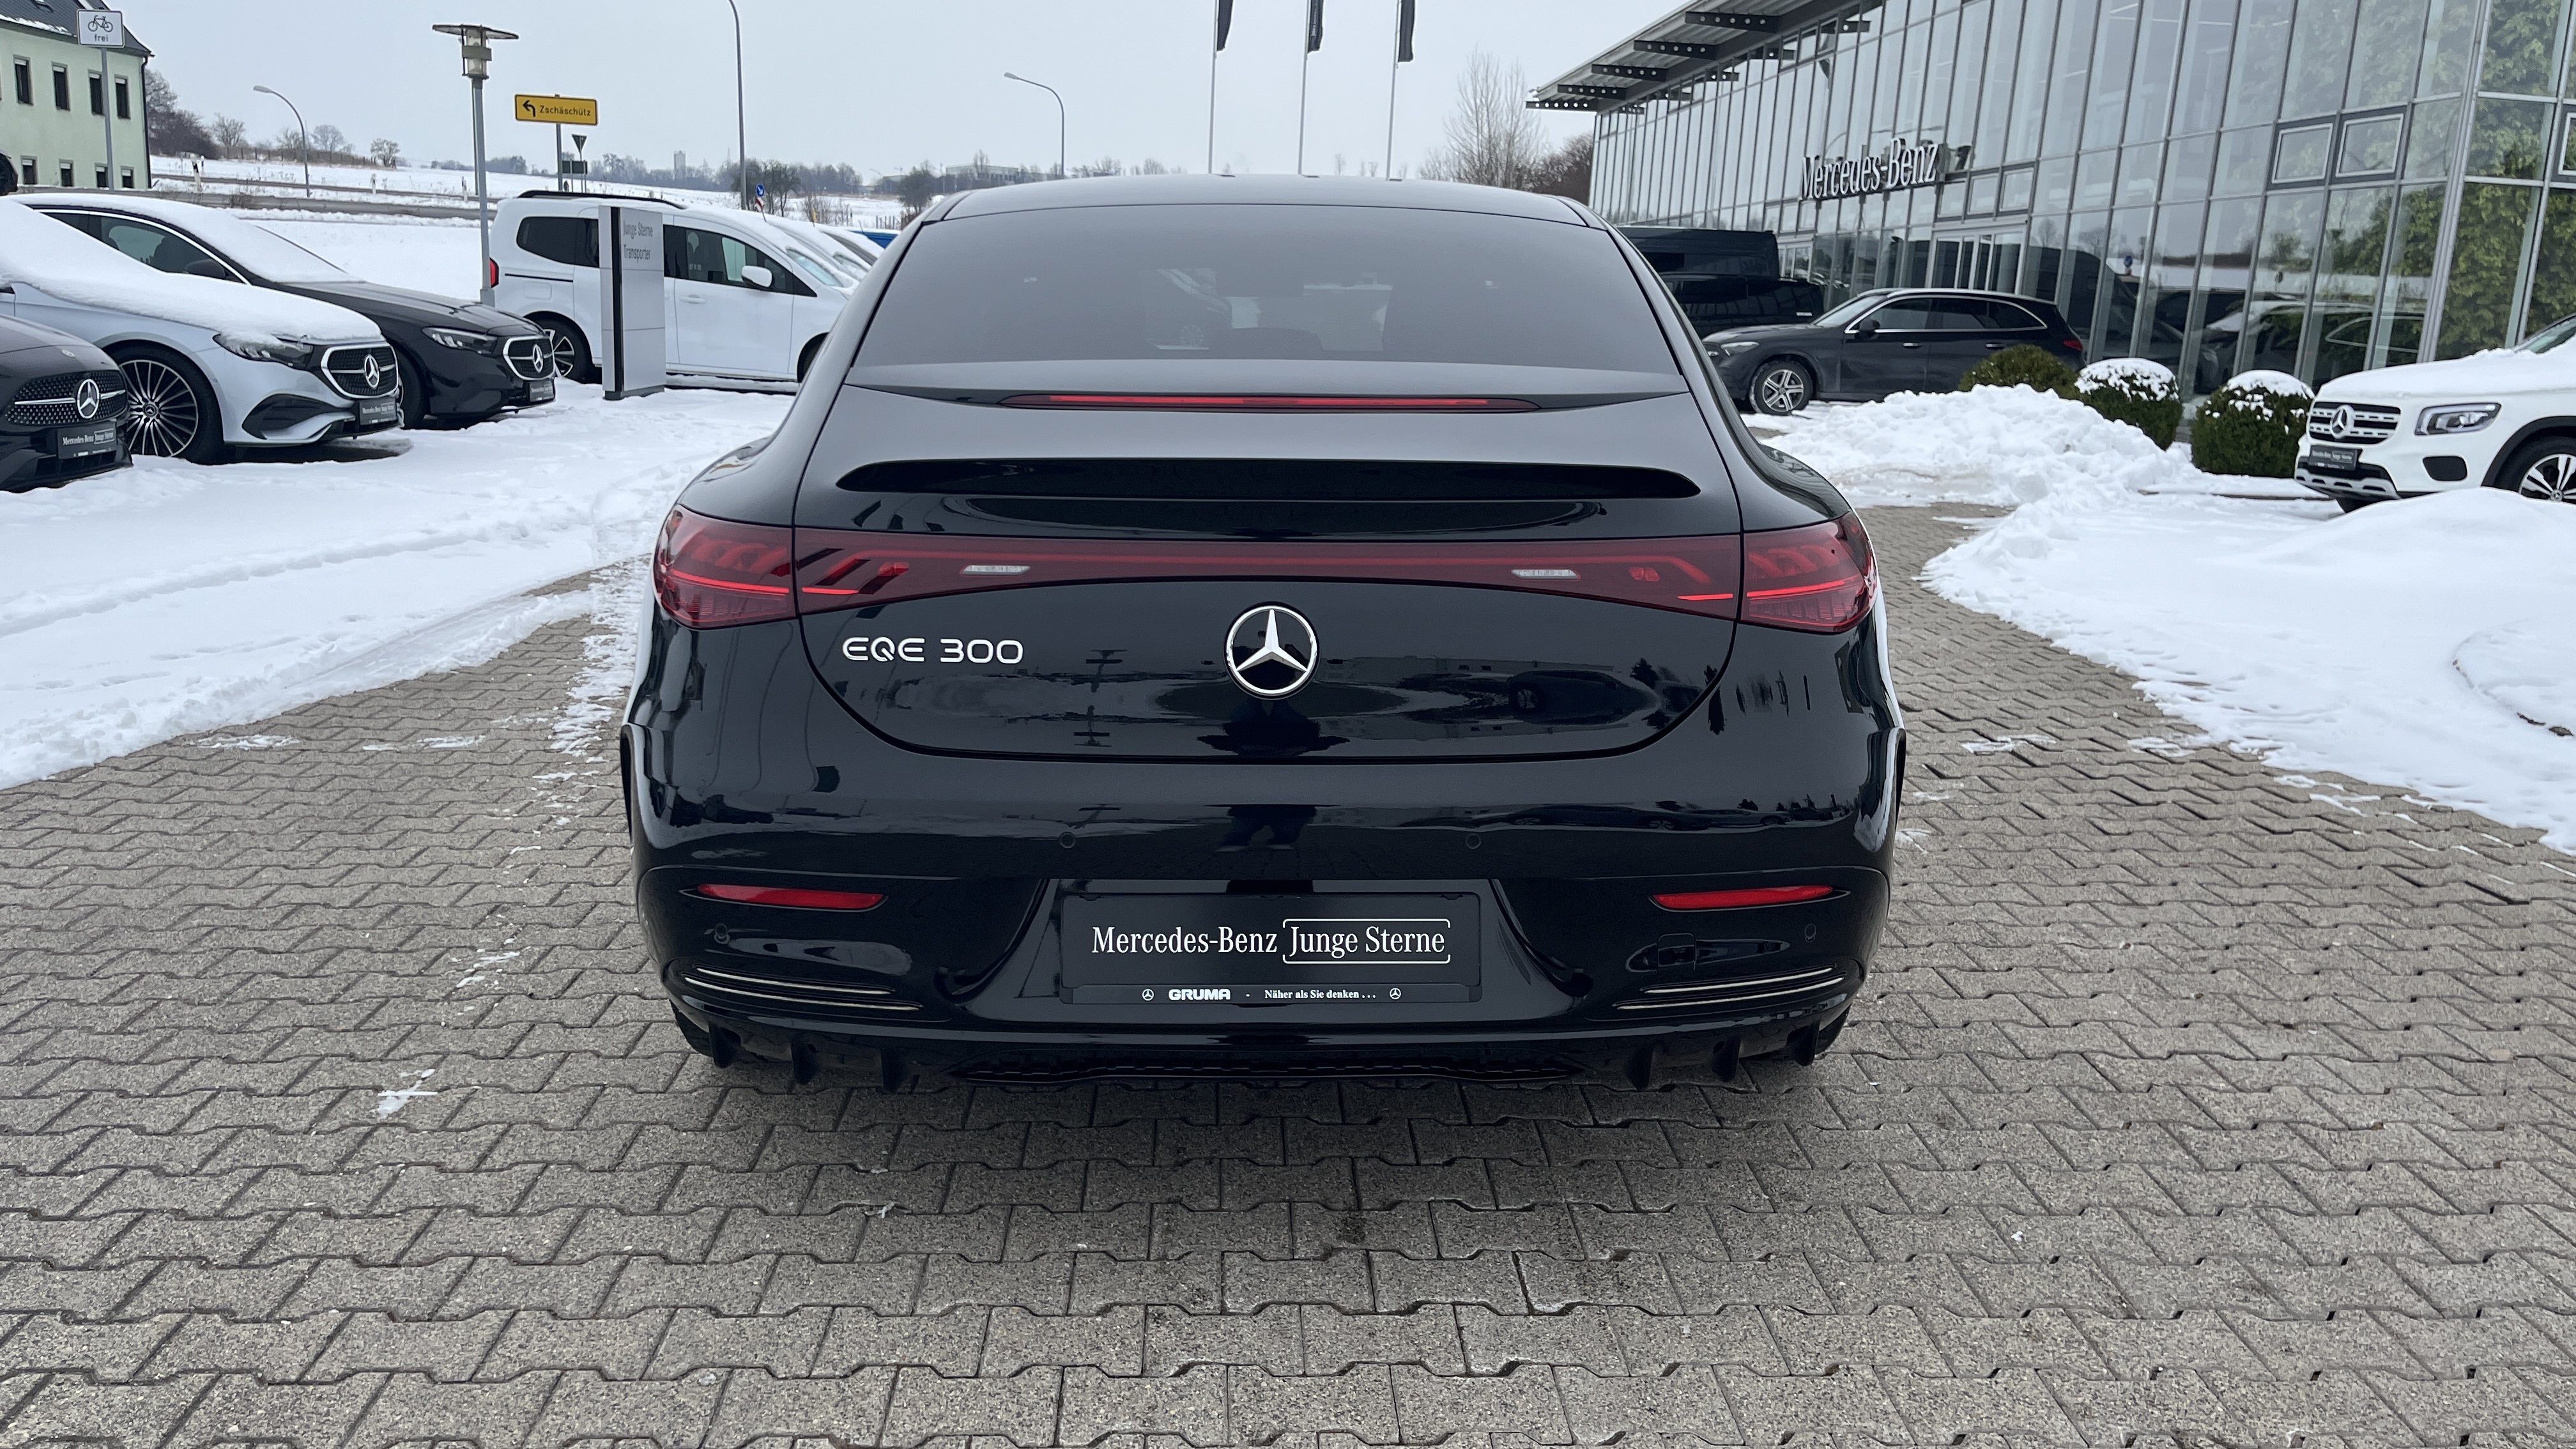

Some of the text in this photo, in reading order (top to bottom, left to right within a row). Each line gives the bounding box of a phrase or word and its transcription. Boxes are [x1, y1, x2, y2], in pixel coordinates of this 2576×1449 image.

[94, 33, 109, 42] frei
[540, 105, 591, 116] Zschäschütz
[1798, 137, 1938, 200] Mercedes-Benz
[624, 220, 653, 239] Junge Sterne
[624, 244, 651, 263] Transporter
[843, 637, 1023, 664] EQE 300
[1091, 926, 1445, 958] Mercedes-Benz Junge Sterne
[1169, 988, 1231, 1000] GRUMA
[1264, 989, 1293, 999] Näher
[1295, 989, 1308, 999] als
[1310, 989, 1324, 999] Sie
[1326, 989, 1360, 999] denken
